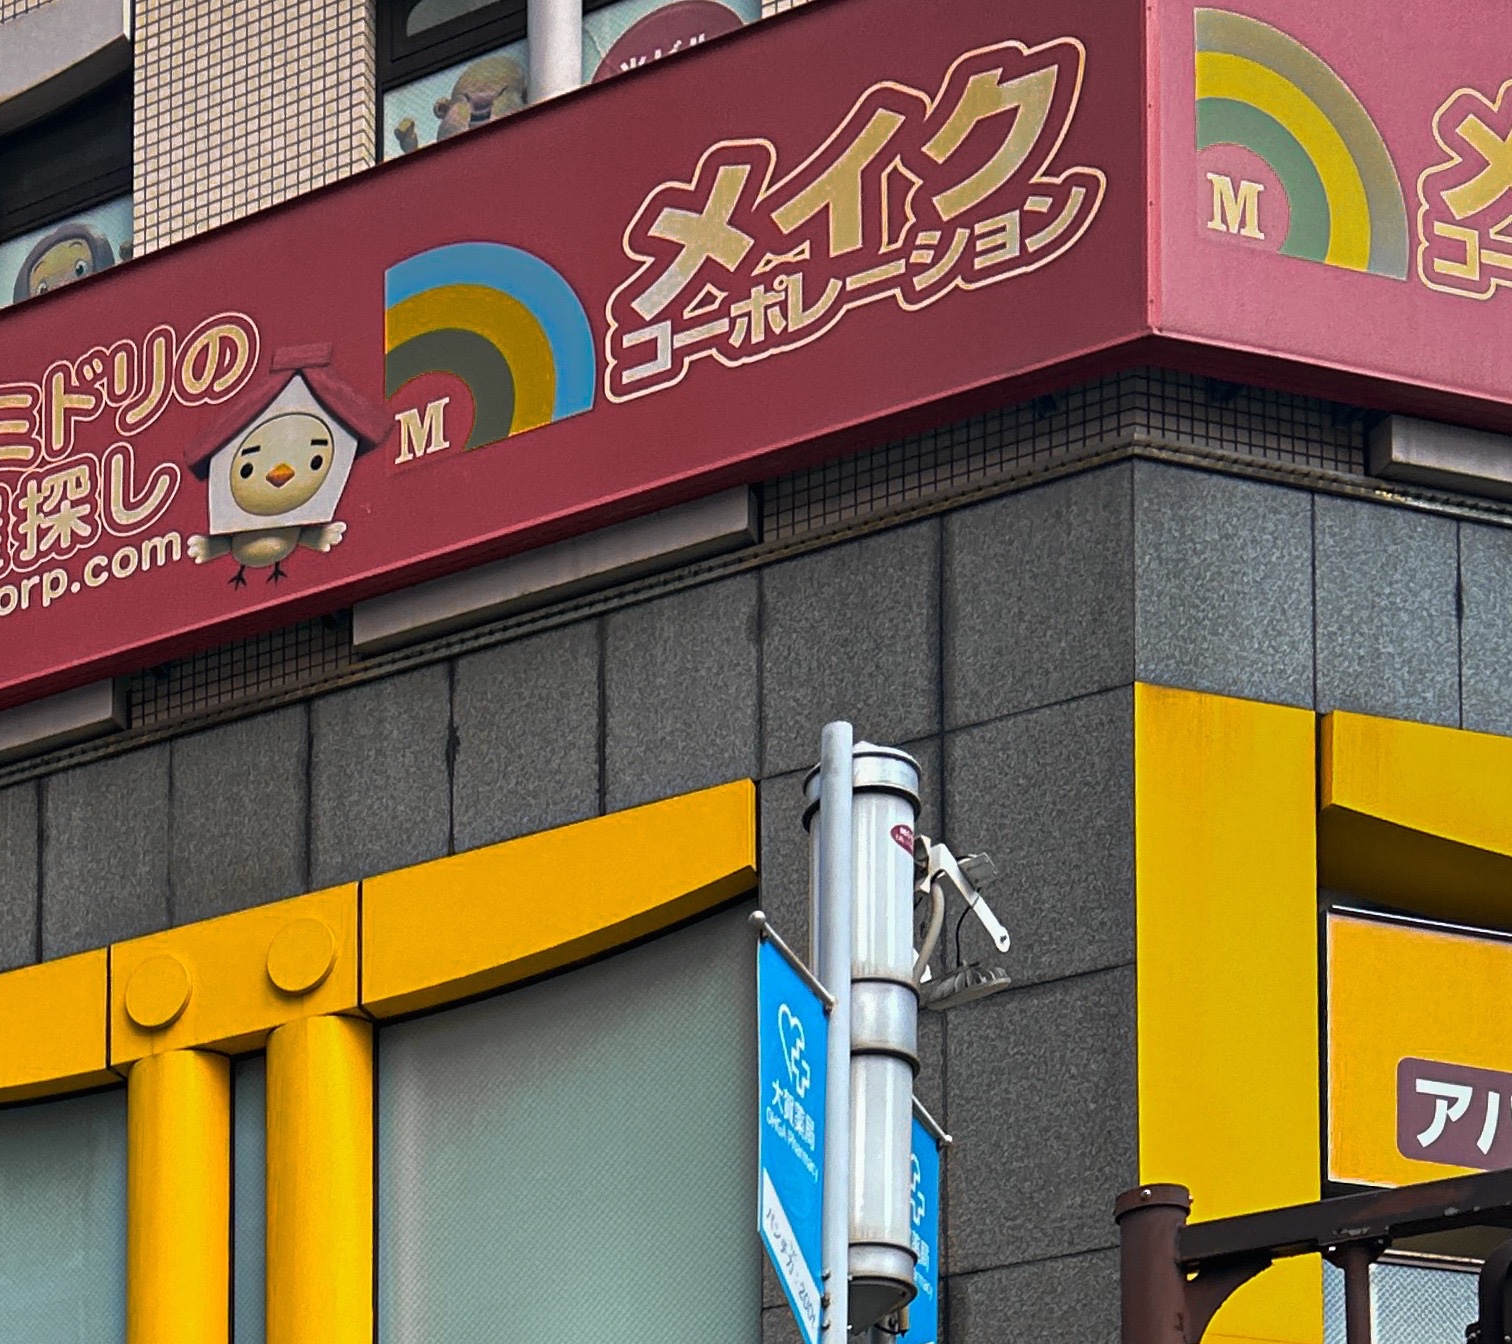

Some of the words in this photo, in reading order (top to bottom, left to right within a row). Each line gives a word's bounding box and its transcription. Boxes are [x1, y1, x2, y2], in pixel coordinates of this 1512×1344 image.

[622, 185, 1086, 384] コーポレーション
[632, 64, 1060, 318] メイク
